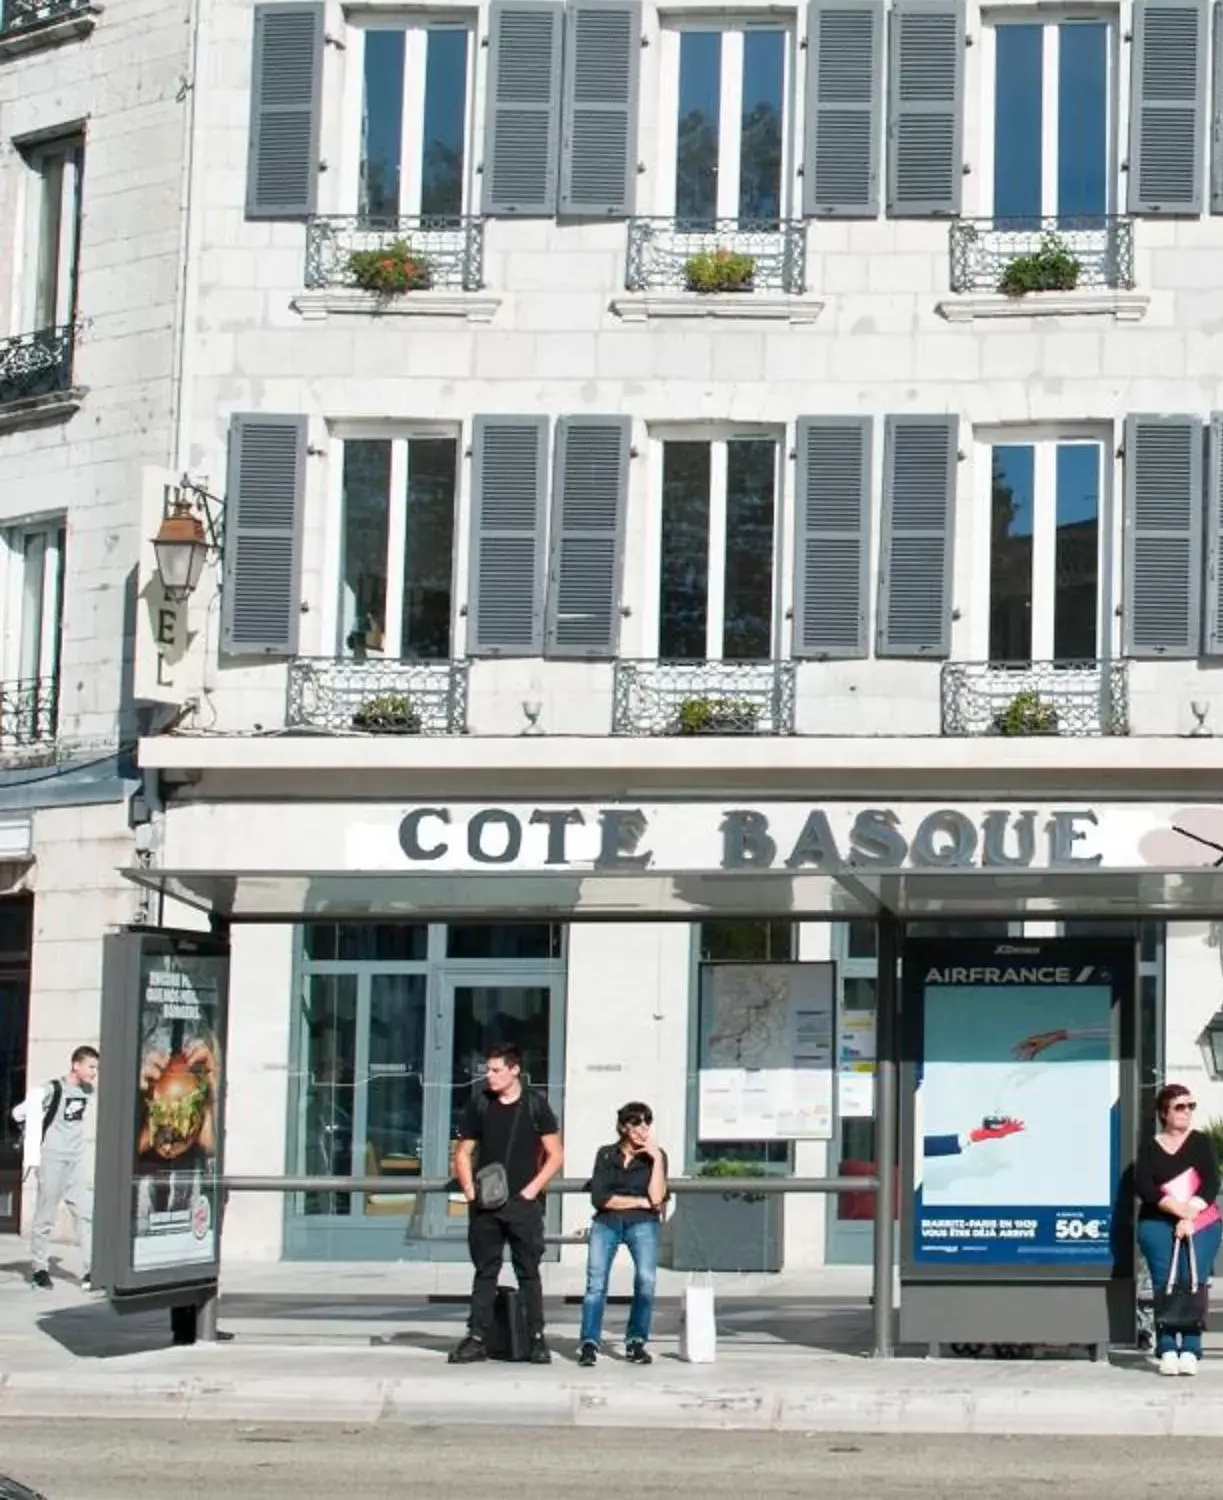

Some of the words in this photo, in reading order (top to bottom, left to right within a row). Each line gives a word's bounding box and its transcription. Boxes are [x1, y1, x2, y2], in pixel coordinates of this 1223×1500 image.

[399, 807, 652, 868] COTE
[721, 809, 1103, 867] BASQUE
[924, 967, 1071, 983] AIRFRANCE
